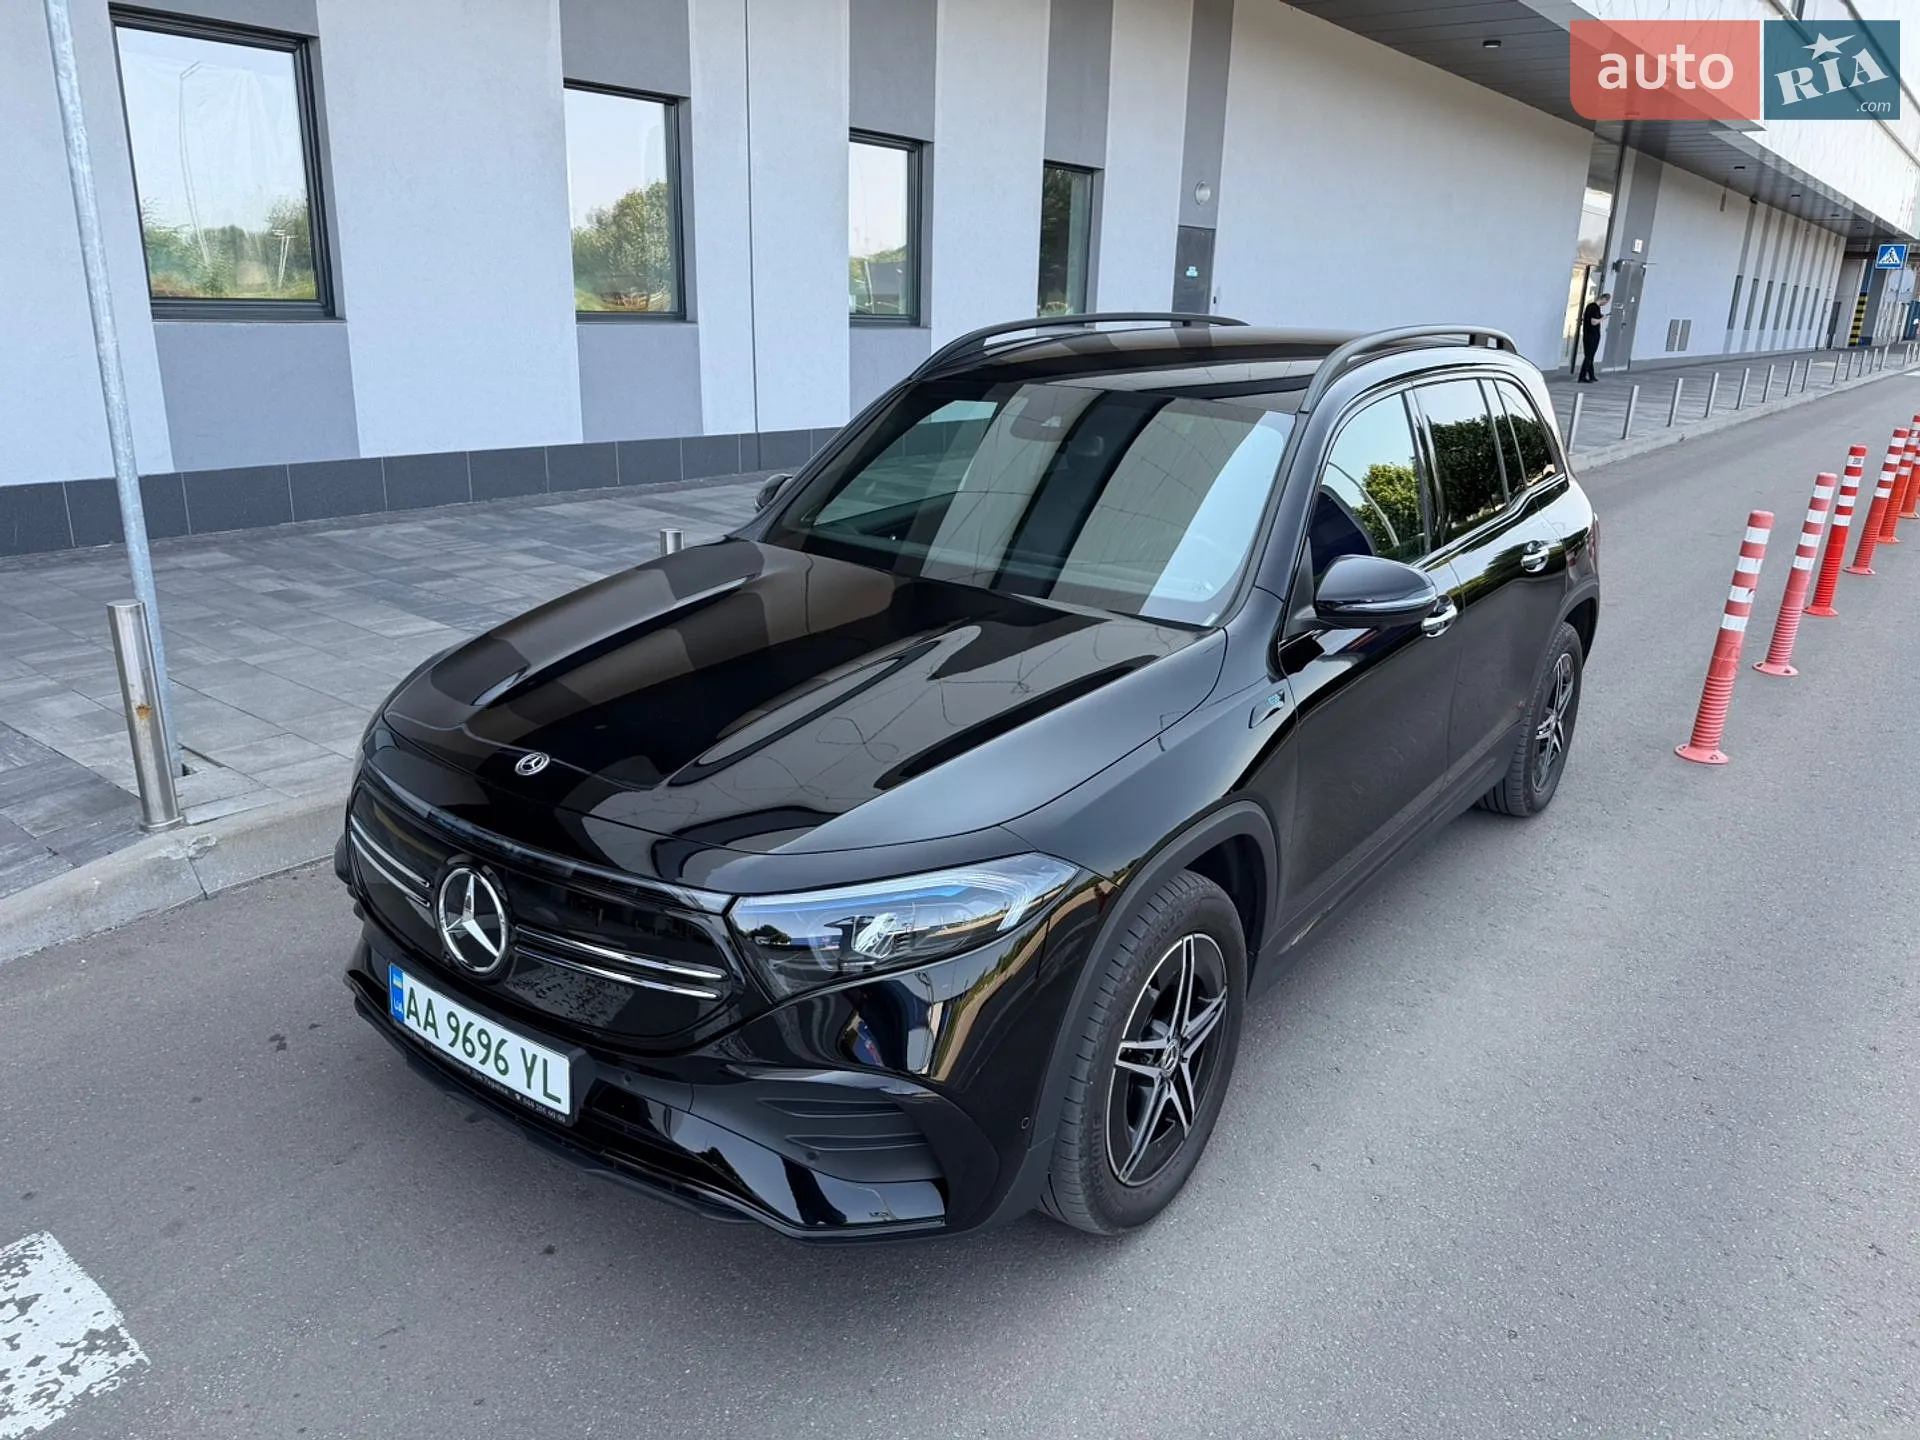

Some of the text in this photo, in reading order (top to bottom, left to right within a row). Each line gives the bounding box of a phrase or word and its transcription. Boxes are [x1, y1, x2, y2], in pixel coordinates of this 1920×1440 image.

[406, 987, 439, 1039] AA
[446, 1011, 510, 1076] 9696
[520, 1047, 562, 1104] YL
